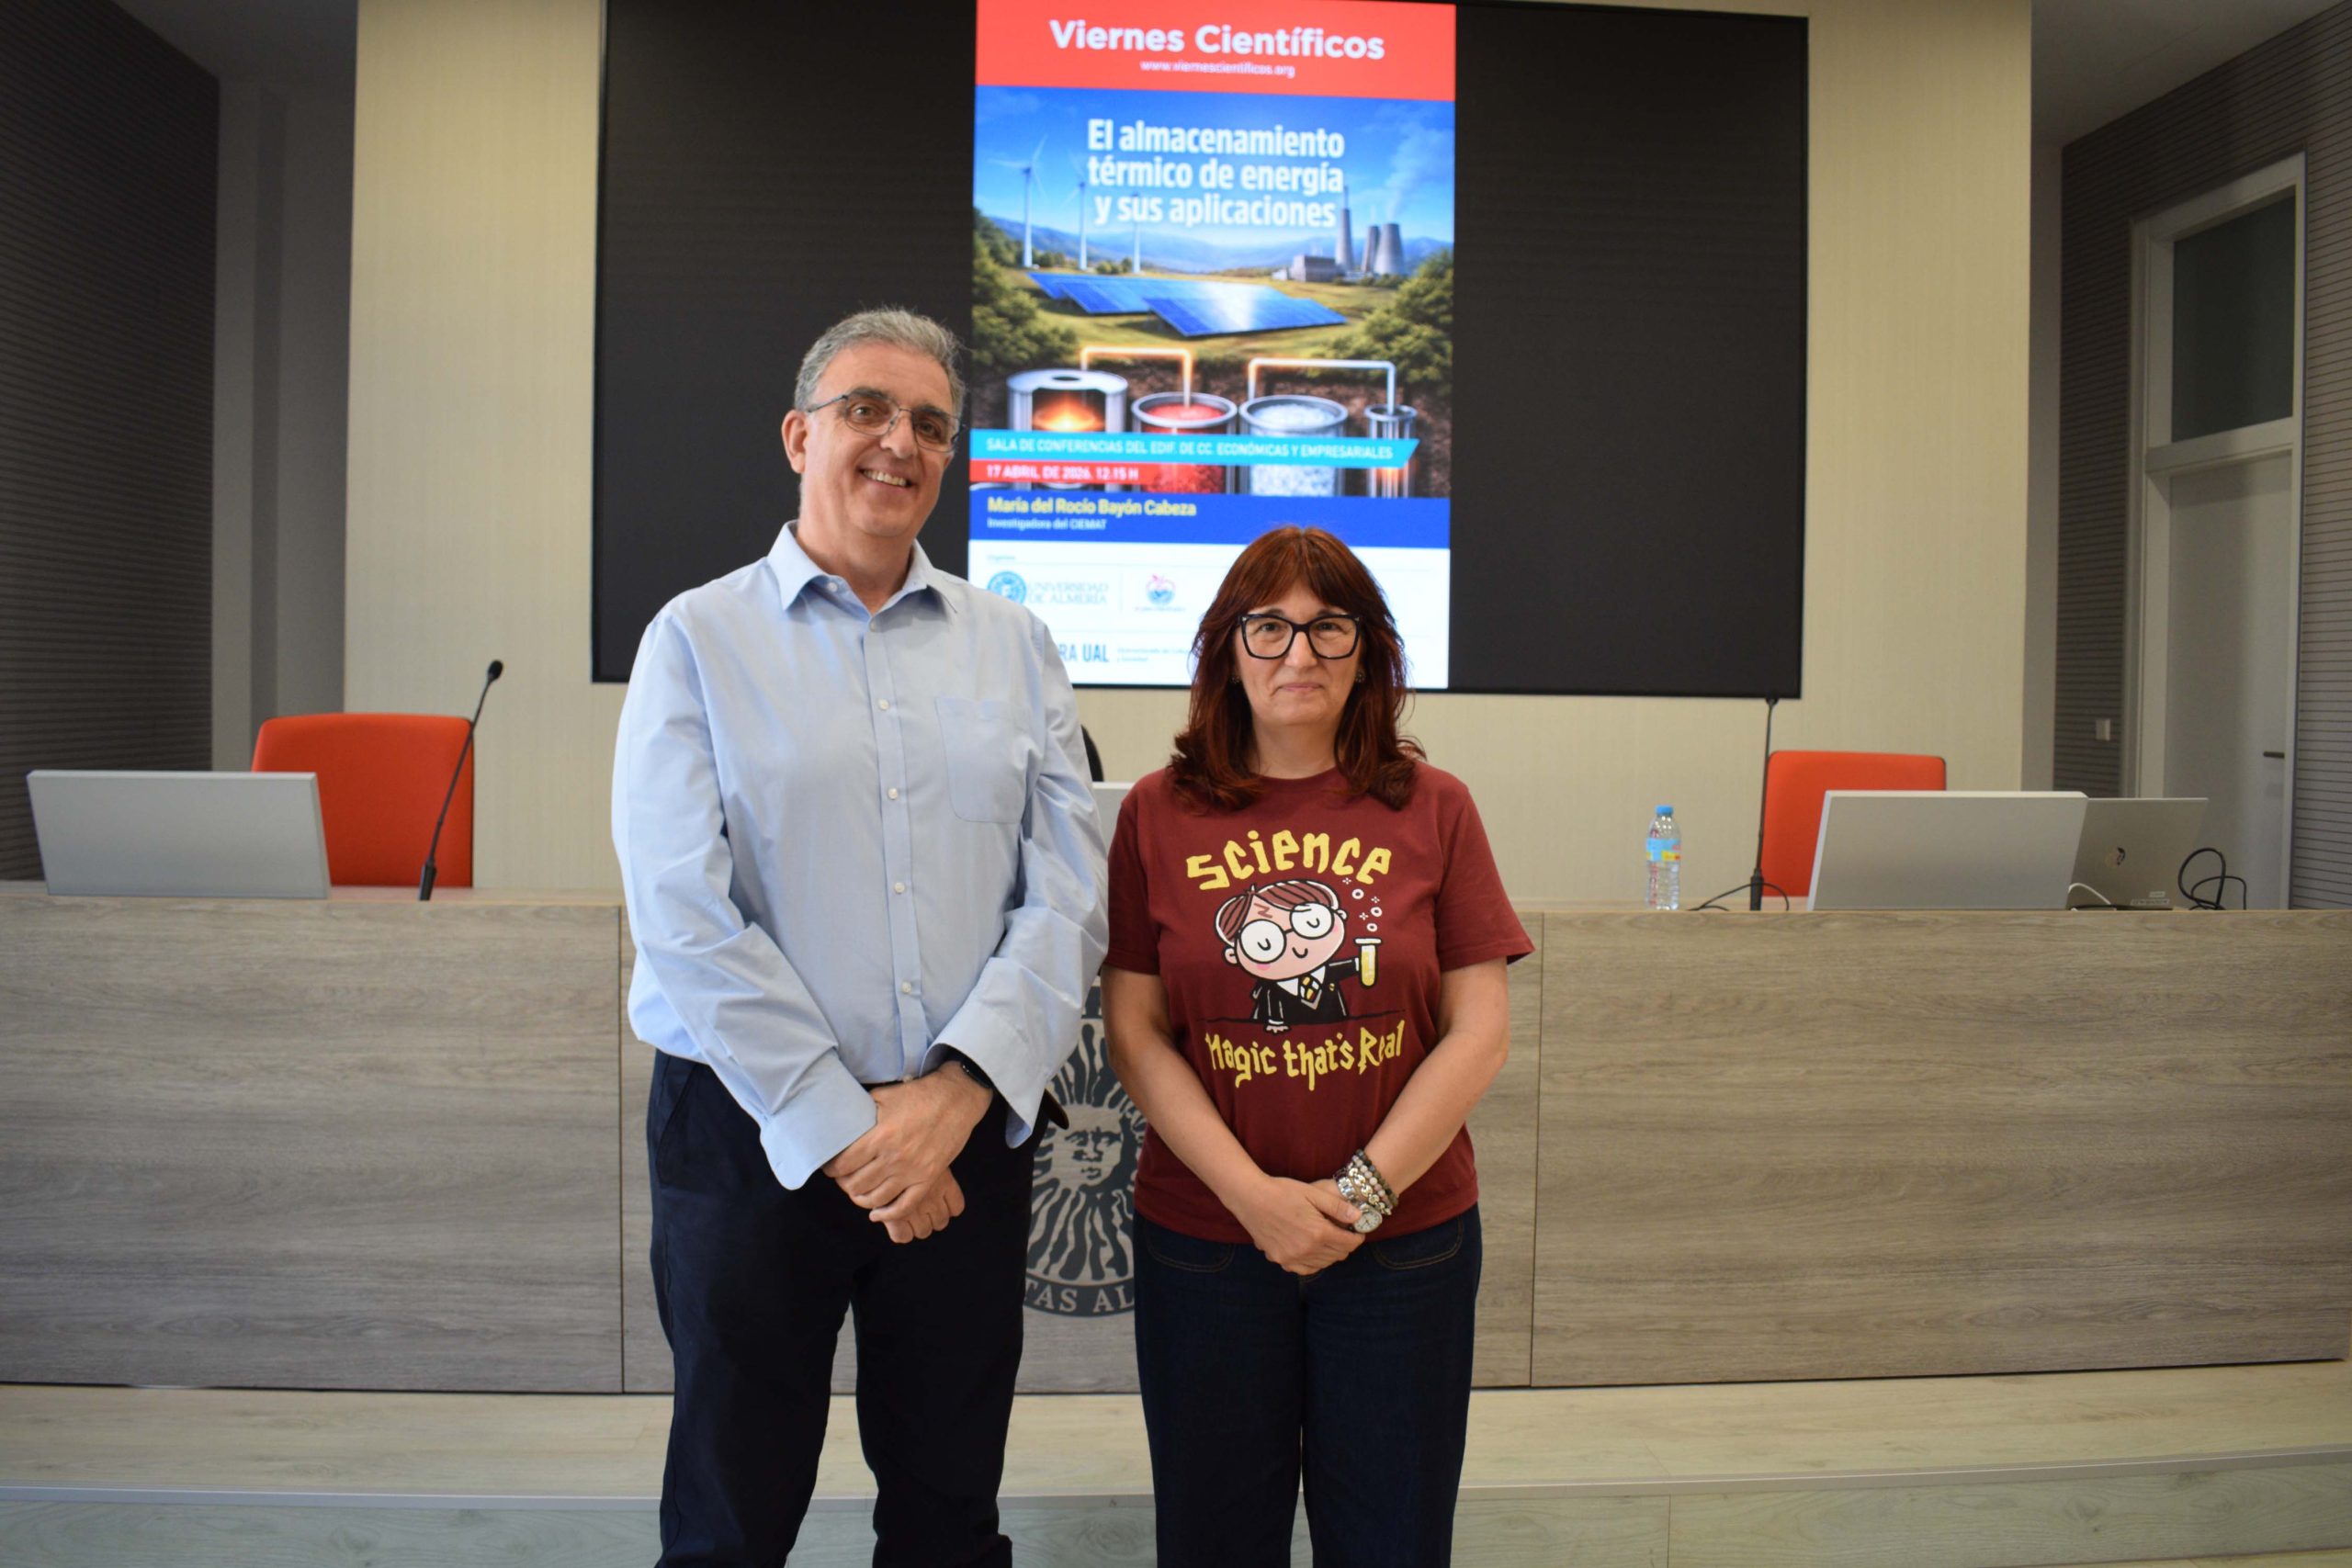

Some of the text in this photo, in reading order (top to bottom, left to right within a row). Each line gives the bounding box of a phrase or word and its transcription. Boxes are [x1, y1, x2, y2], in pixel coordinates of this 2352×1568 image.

[1049, 19, 1385, 60] Viernes Científicos
[1088, 118, 1345, 158] El almacenamiento
[1088, 154, 1343, 197] térmico de energía
[1094, 193, 1336, 228] y sus aplicaciones
[987, 438, 1017, 452] SALA
[1020, 438, 1035, 452] DE
[1036, 438, 1124, 454] CONFERENCIAS
[1125, 440, 1148, 455] DEL
[1179, 441, 1195, 456] DE
[1217, 440, 1291, 457] ECONÓMICAS
[1292, 444, 1299, 457] Y
[1301, 444, 1393, 459] EMPRESARIALES
[987, 464, 1001, 478] 17
[1002, 465, 1041, 479] ABRIL
[1042, 466, 1059, 479] DE
[1128, 468, 1138, 480] H
[988, 496, 1029, 513] María
[1031, 497, 1054, 514] del
[1098, 498, 1142, 517] Bayón
[1145, 500, 1197, 517] Cabeza
[1053, 517, 1069, 530] del
[1082, 644, 1110, 662] UAL
[1205, 1032, 1277, 1089] Magic
[1358, 1020, 1405, 1076] Real
